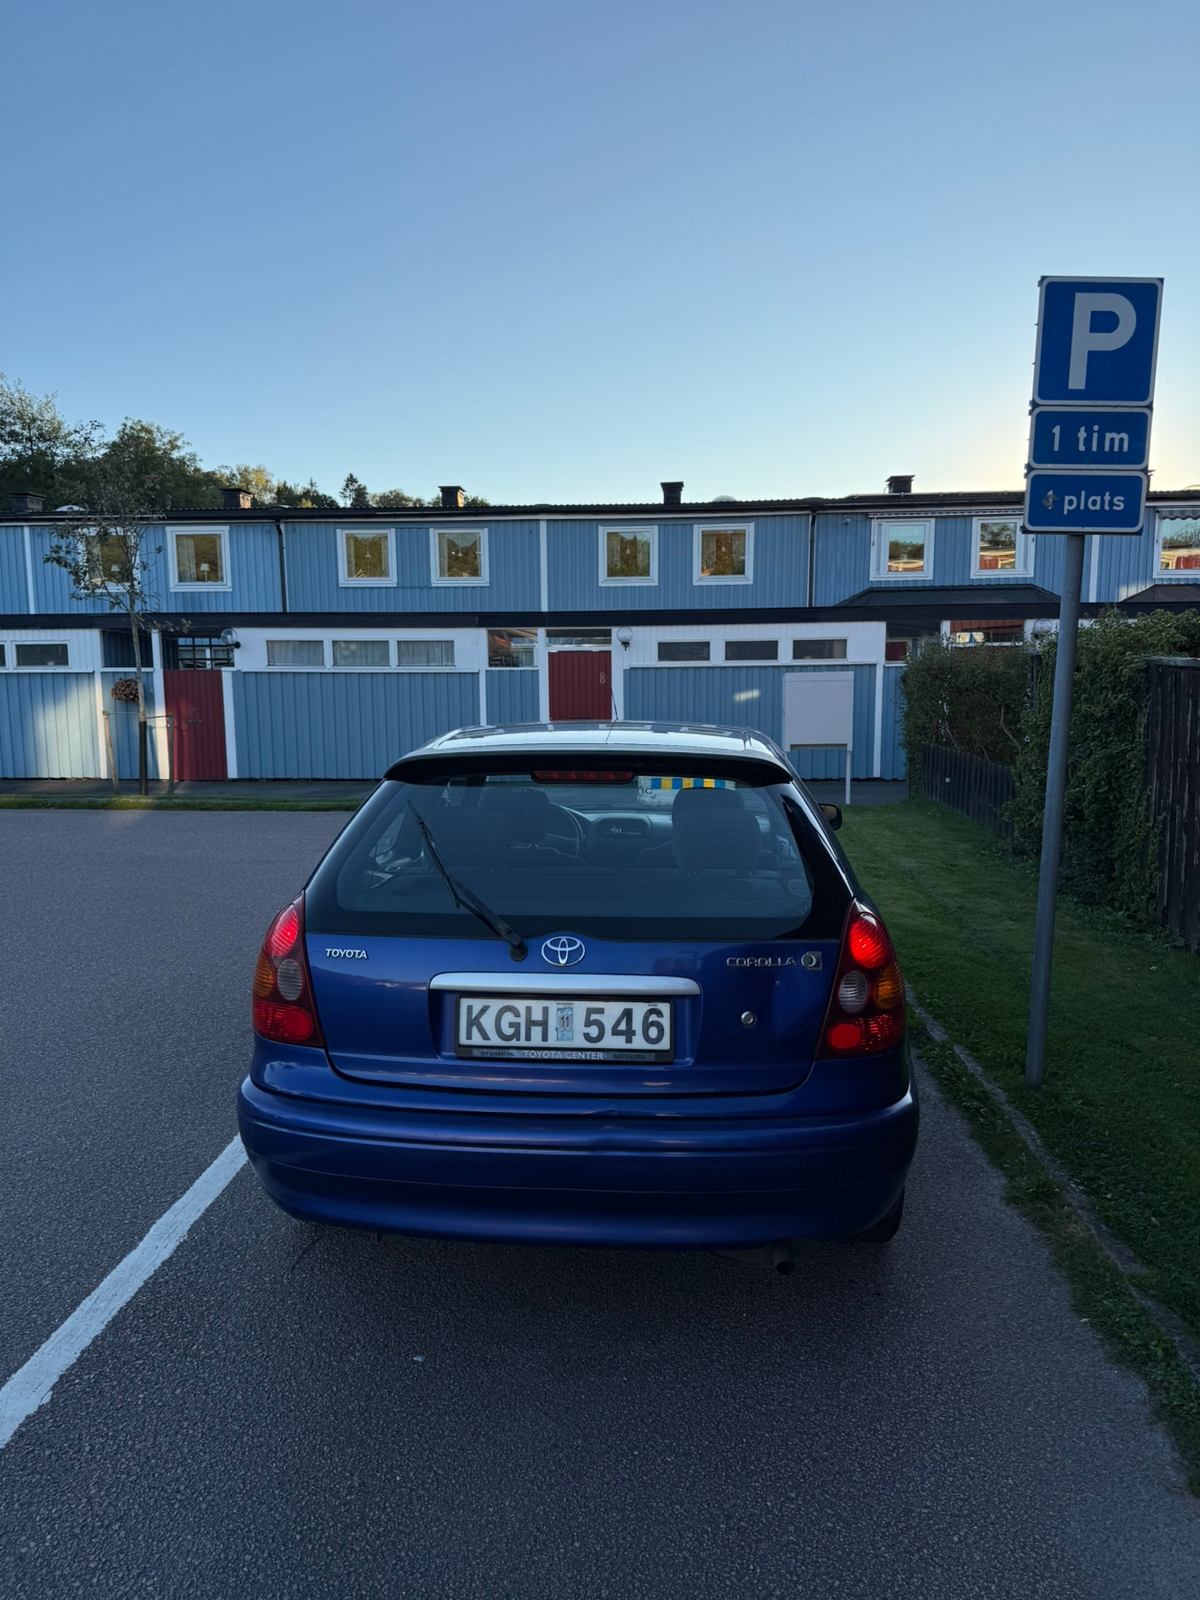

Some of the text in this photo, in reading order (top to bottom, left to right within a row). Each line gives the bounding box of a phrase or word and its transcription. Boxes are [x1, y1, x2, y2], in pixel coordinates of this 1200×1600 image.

[1068, 292, 1137, 390] P
[1052, 425, 1129, 452] 1 tim
[1063, 490, 1125, 515] plats
[599, 671, 606, 685] 8
[325, 948, 368, 959] TOYOTA
[726, 956, 797, 967] COROLLA
[465, 1004, 665, 1045] KGH 546
[523, 1050, 563, 1059] TOYOTA
[565, 1050, 604, 1060] CENTER
